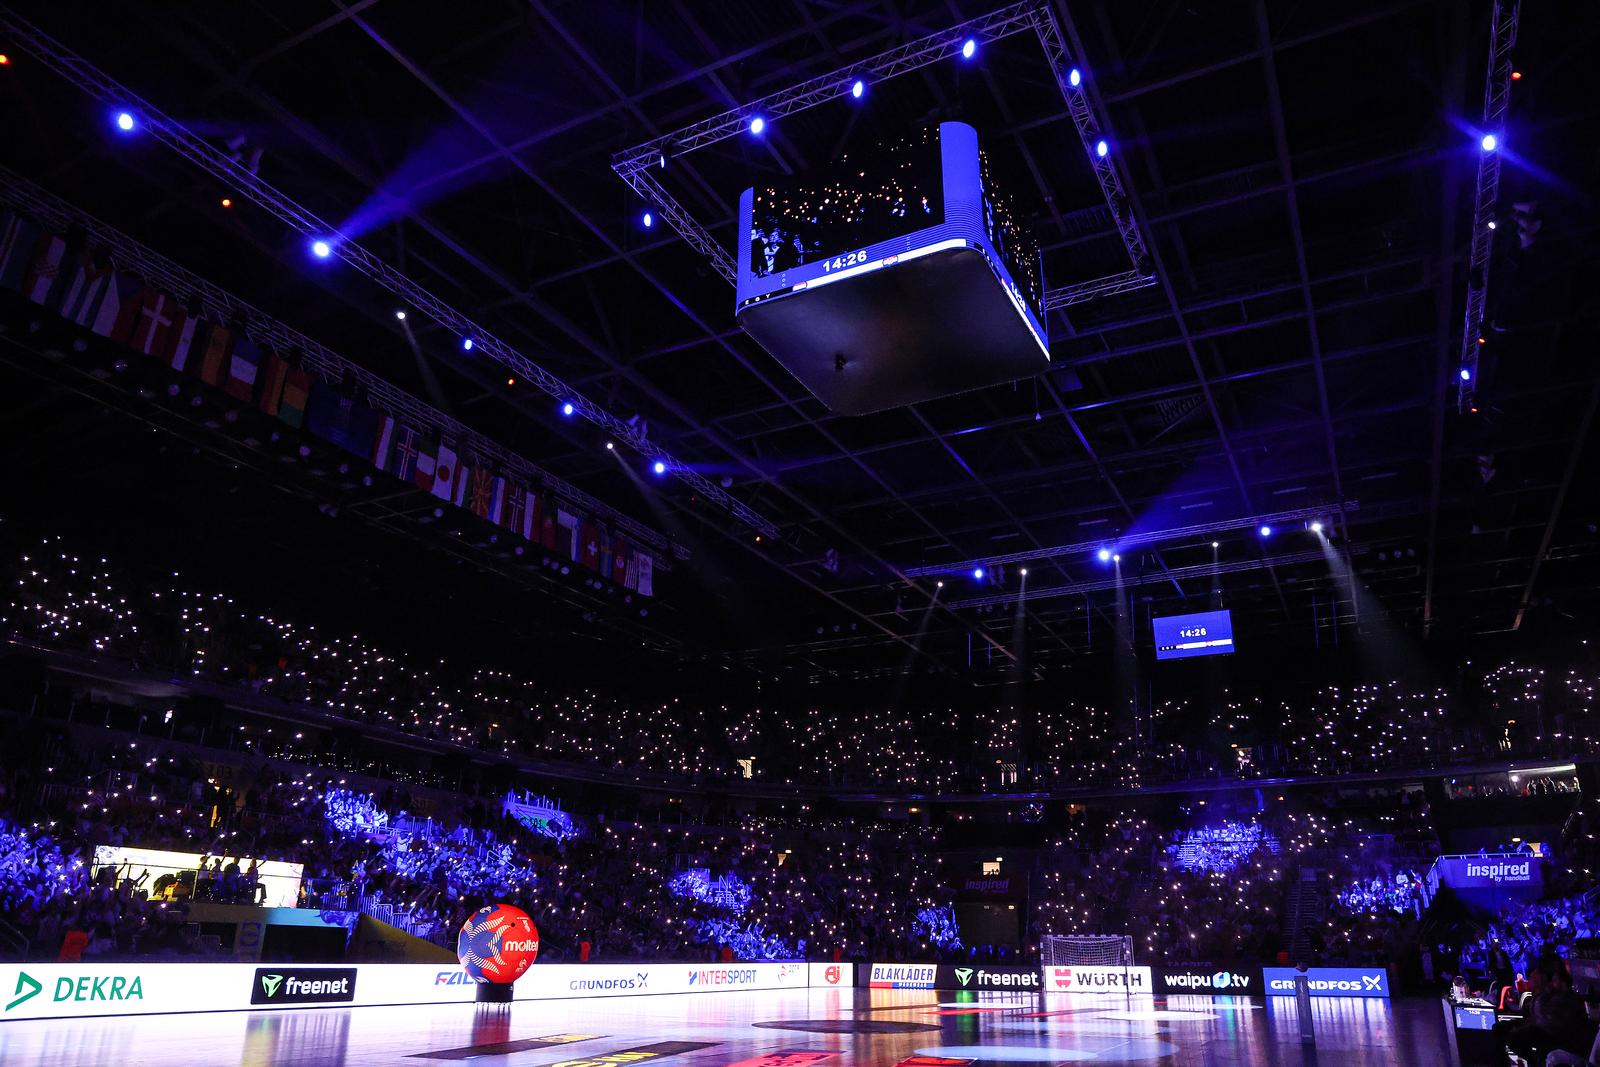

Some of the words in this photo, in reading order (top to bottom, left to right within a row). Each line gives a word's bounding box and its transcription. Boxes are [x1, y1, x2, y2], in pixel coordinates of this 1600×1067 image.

[822, 250, 868, 273] 14:26
[1180, 627, 1207, 638] 14:26
[1466, 861, 1530, 879] inspired
[284, 972, 349, 996] freenet
[570, 978, 635, 991] GRUNDFOS
[698, 969, 757, 985] INTERSPORT
[977, 970, 1039, 986] freenet
[1077, 972, 1142, 987] WÜRTH
[53, 975, 144, 1002] DEKRA
